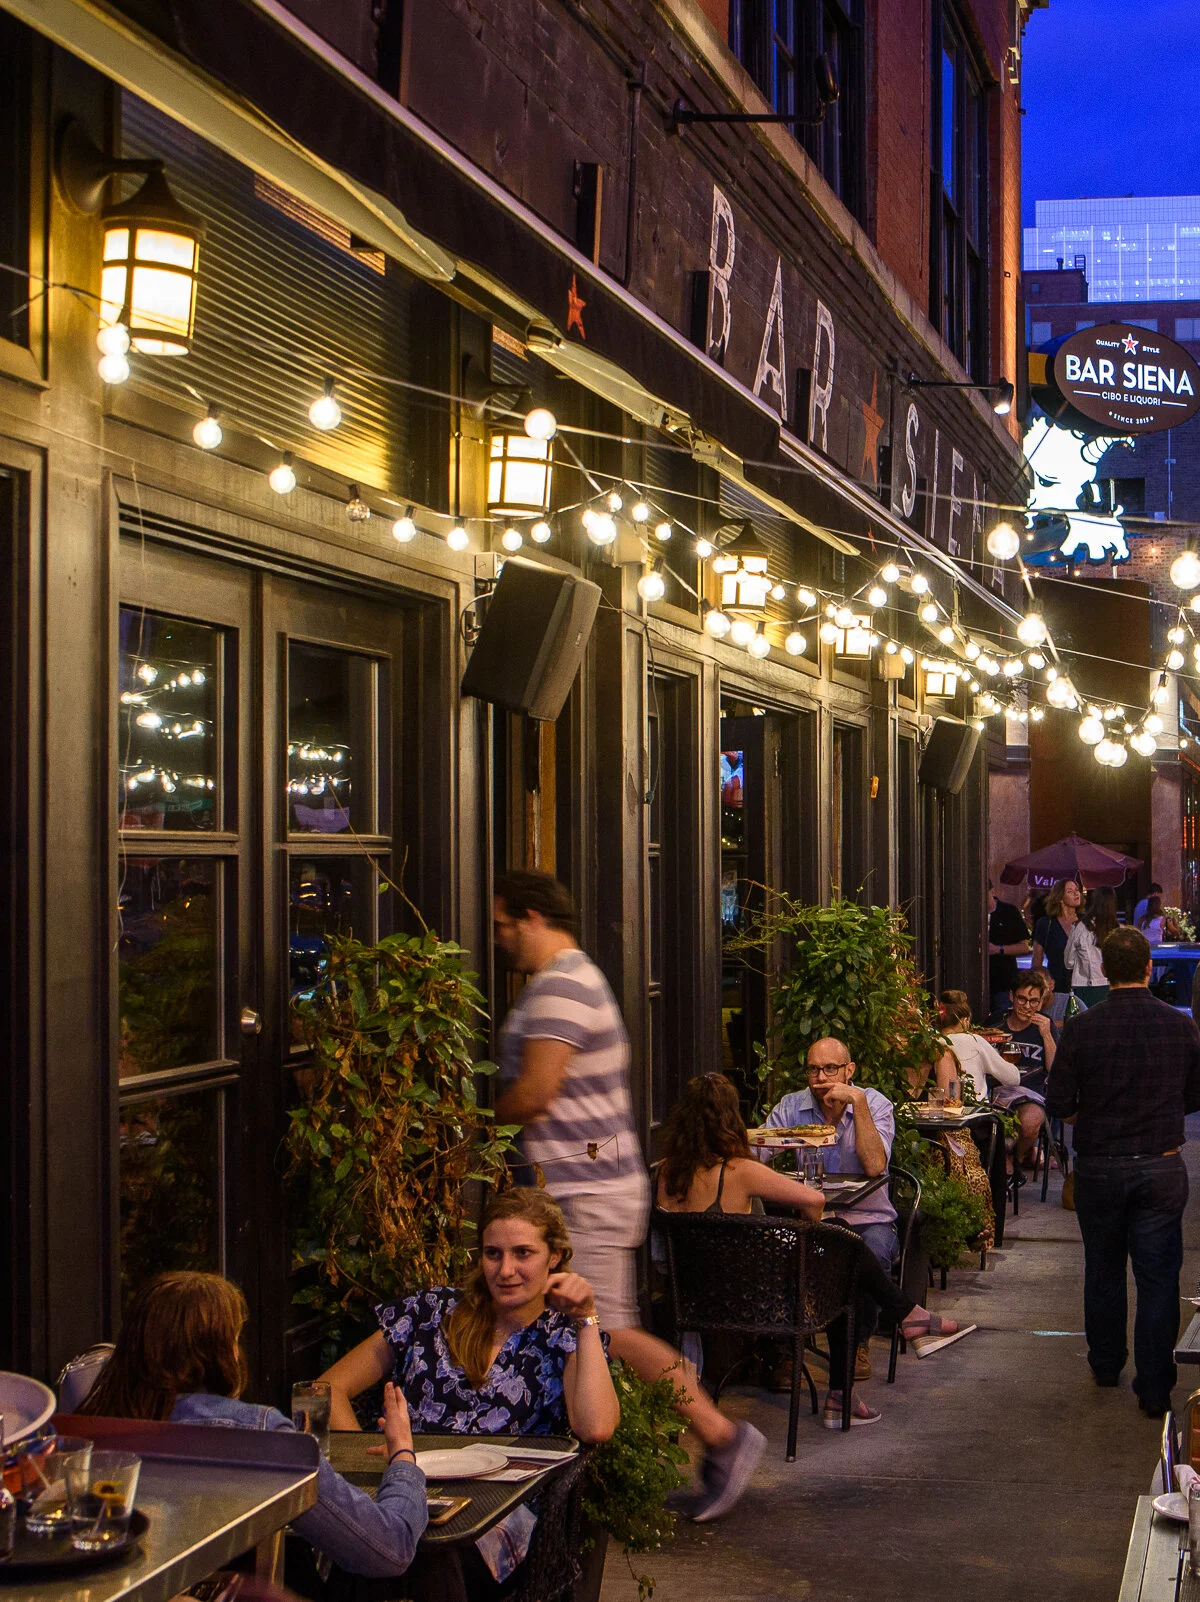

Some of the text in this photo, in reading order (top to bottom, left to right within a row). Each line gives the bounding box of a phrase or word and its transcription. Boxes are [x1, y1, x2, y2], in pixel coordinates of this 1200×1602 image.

[706, 183, 836, 455] BAR
[1095, 339, 1160, 354] QUALITY STYLE
[1065, 354, 1195, 396] BAR SIENA
[1101, 391, 1161, 406] CIBO E LIQUORI
[1113, 413, 1149, 425] SINCE 2015
[1034, 875, 1057, 887] Val
